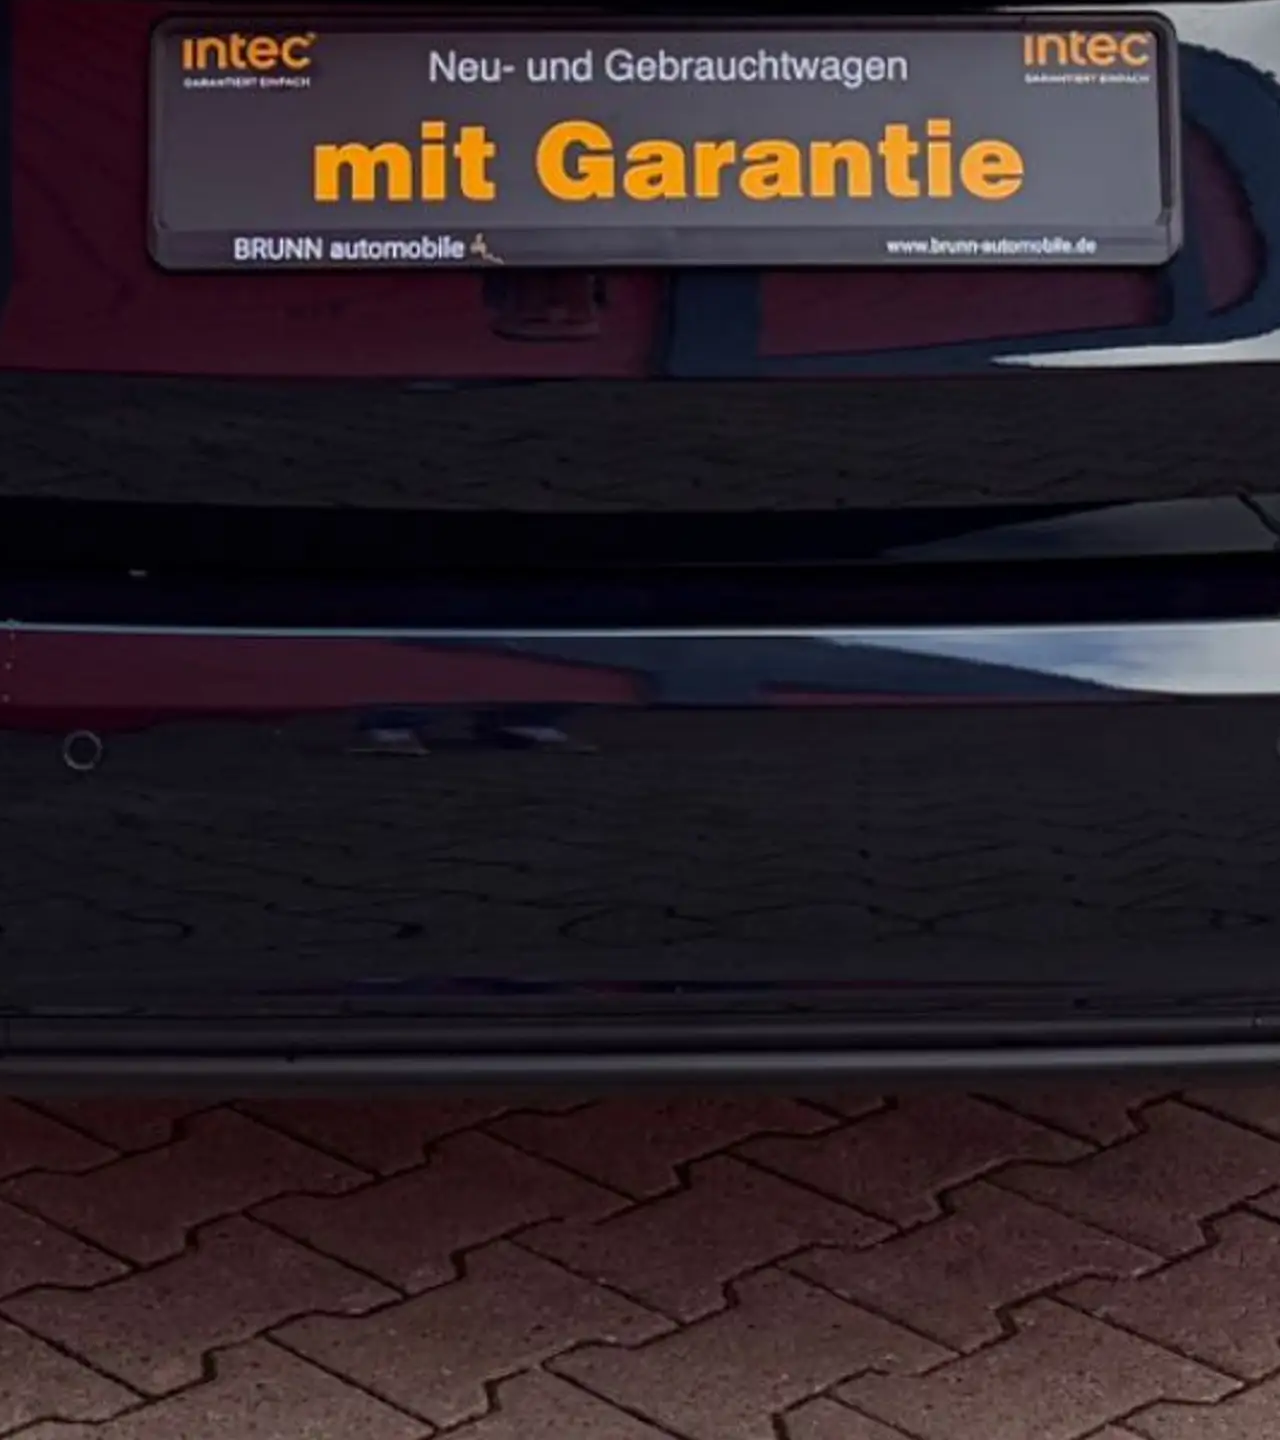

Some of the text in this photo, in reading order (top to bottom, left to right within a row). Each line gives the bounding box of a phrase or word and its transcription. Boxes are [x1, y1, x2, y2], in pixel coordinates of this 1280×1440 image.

[182, 32, 312, 71] intec
[1023, 30, 1151, 67] intec
[428, 48, 909, 89] Neu- und Gebrauchtwagen
[313, 118, 1025, 201] mit Garantie
[233, 235, 465, 260] BRUNN automobile
[886, 236, 1098, 255] www.brunn-automobile.de
